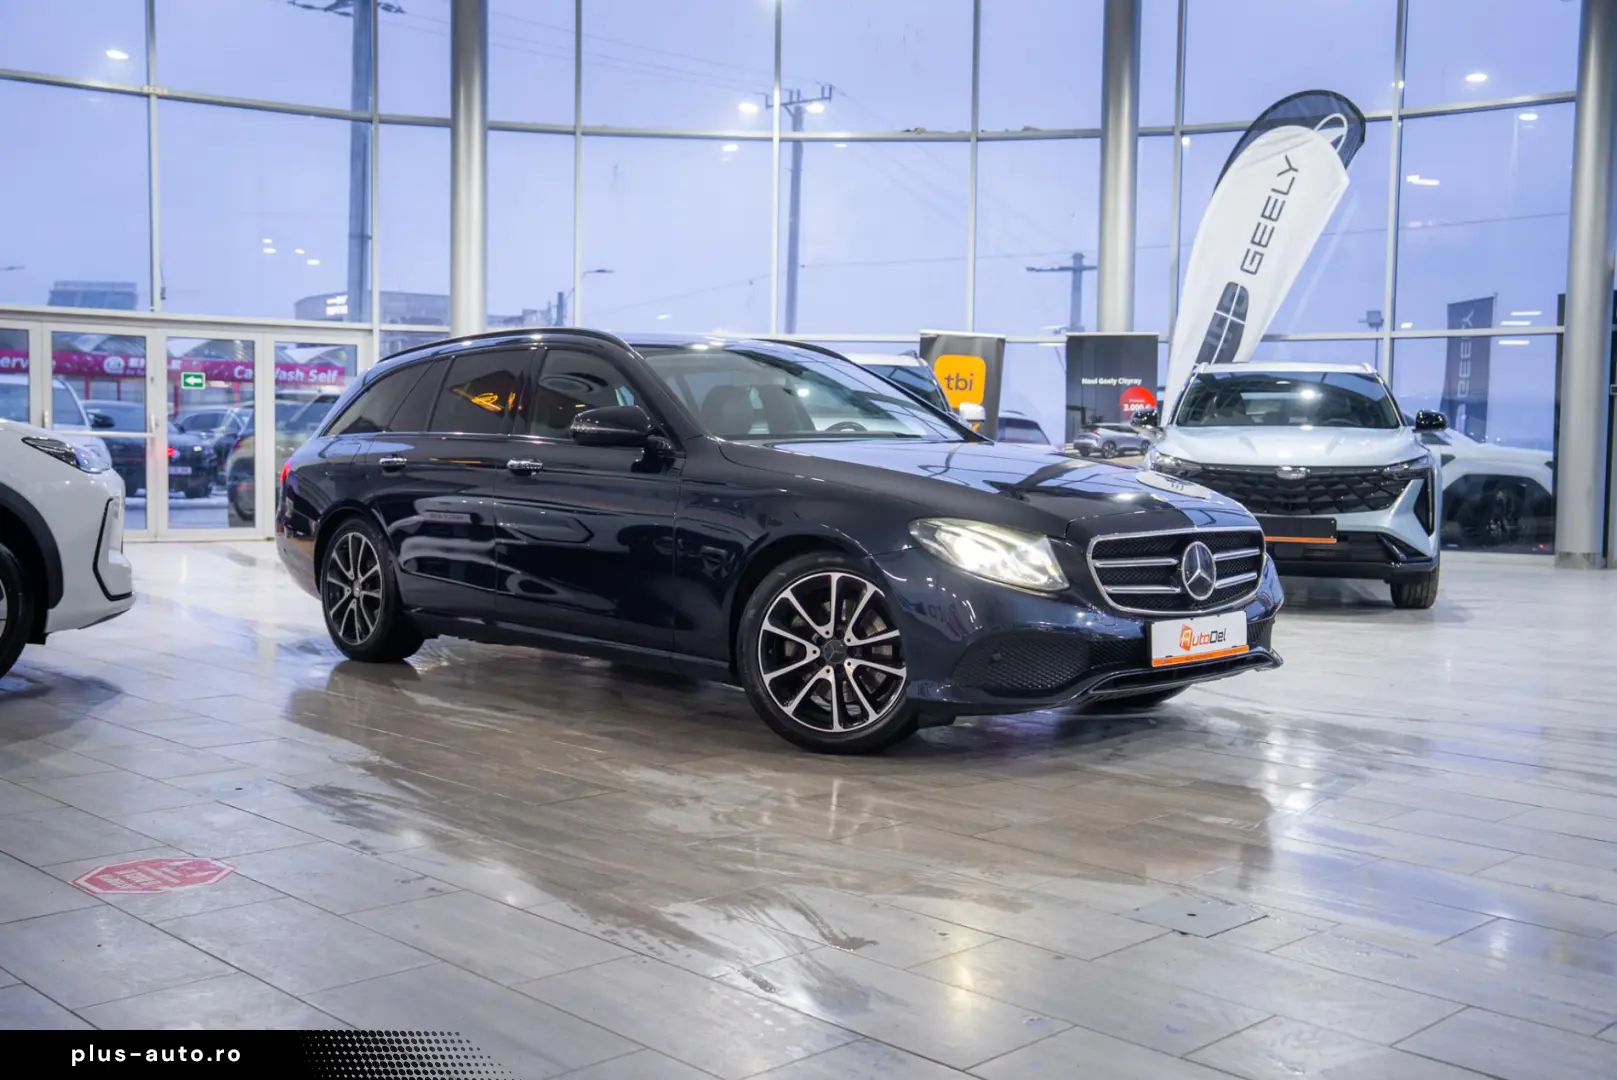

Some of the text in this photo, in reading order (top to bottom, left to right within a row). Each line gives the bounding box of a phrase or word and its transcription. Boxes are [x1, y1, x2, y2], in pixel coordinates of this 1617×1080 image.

[1240, 154, 1298, 275] GEELY
[275, 368, 303, 381] ash
[308, 369, 338, 383] Self
[944, 372, 974, 391] tbi
[1099, 378, 1117, 386] Geely
[1179, 624, 1227, 651] AutoDel
